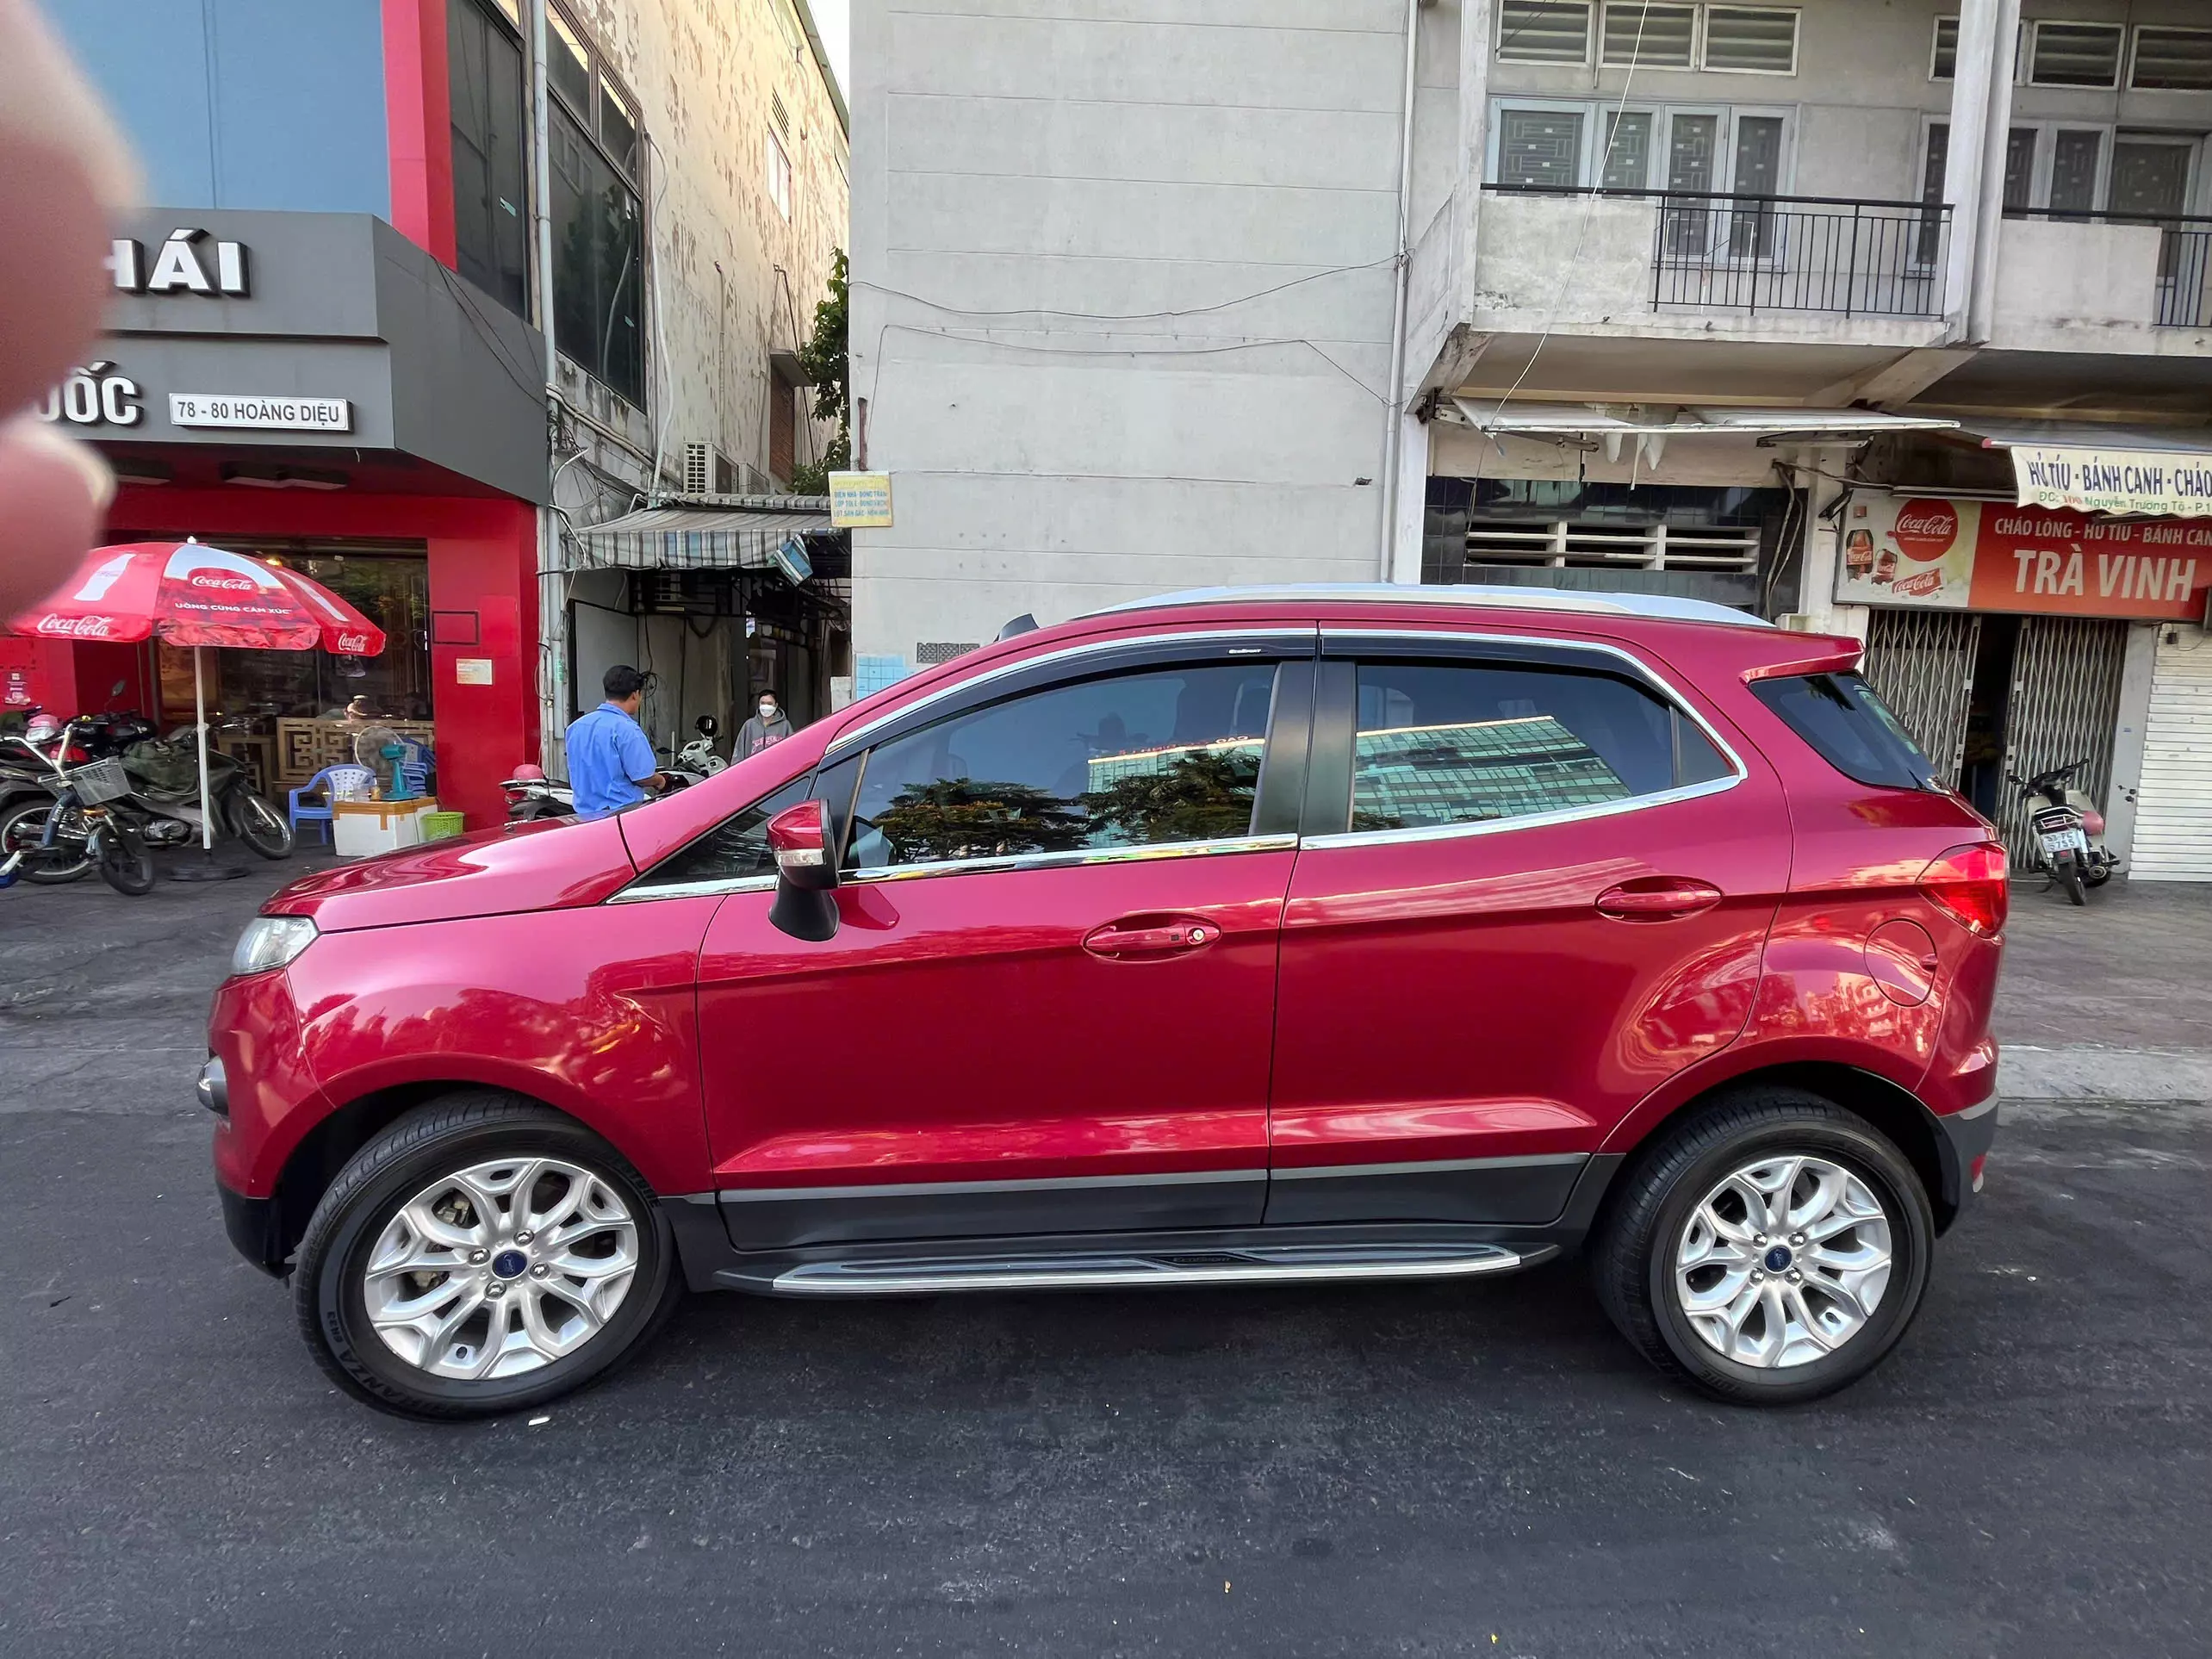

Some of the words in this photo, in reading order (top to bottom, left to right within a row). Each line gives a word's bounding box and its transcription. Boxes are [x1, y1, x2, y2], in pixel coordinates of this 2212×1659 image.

[177, 401, 196, 418] 78
[211, 402, 228, 419] 80
[234, 400, 295, 421] HOÀNG
[301, 402, 339, 426] DIỆU
[2083, 457, 2122, 492] BÁNH
[2125, 465, 2164, 494] CANH
[2175, 462, 2212, 498] CHÁO
[1897, 513, 1954, 534] Coca-Cola
[1995, 516, 2032, 535] CHÁO
[2035, 518, 2072, 537] LÒNG
[2142, 524, 2183, 544] BÁNH
[191, 575, 253, 590] Coca-Cola
[2014, 544, 2084, 596] TRÀ
[2098, 554, 2196, 601] VINH
[37, 613, 115, 636] Coca-Cola
